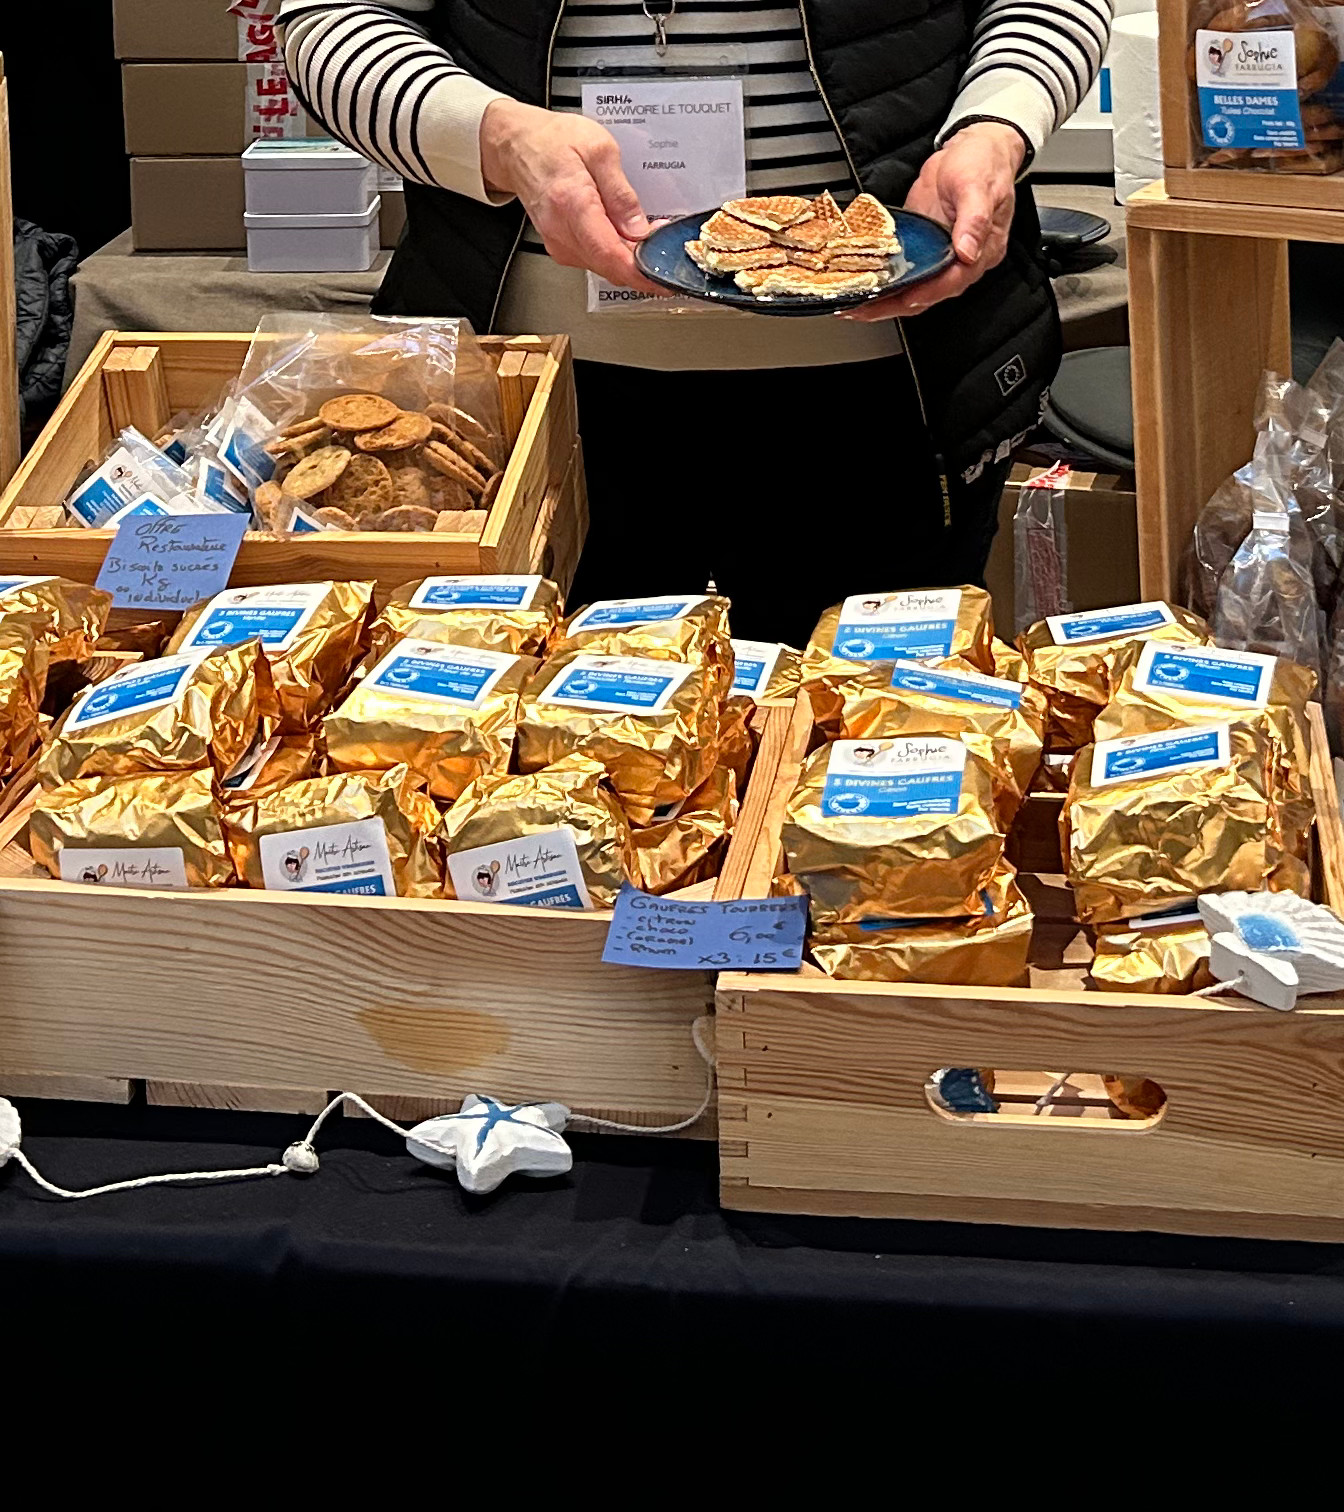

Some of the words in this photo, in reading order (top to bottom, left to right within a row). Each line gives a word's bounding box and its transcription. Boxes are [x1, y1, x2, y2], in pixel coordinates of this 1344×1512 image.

[1245, 94, 1279, 107] DAMES
[662, 103, 676, 115] LE
[679, 101, 732, 115] TOUQUET
[648, 138, 678, 150] Sophie
[642, 161, 687, 171] FARRUGIA
